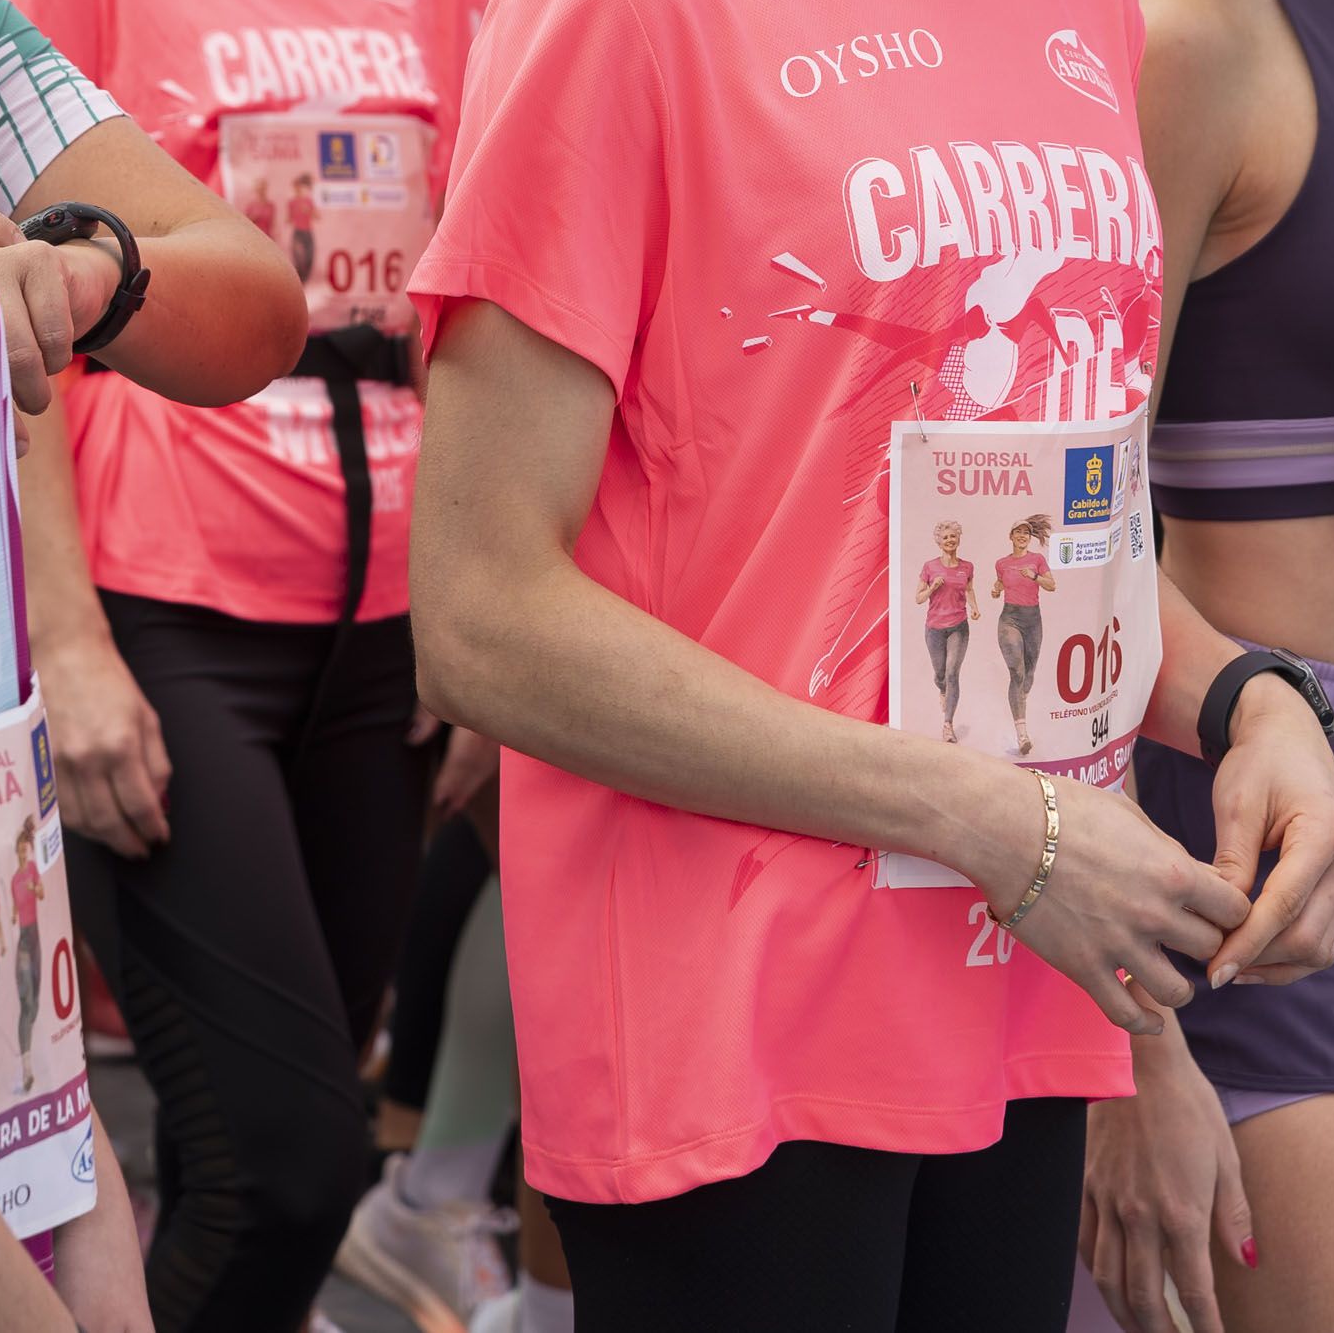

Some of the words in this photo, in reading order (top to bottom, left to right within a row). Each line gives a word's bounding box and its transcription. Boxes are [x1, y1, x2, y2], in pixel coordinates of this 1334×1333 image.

[201, 25, 439, 108] CARRERA
[780, 28, 943, 98] OYSHO
[842, 141, 1163, 282] CARRERA
[326, 249, 405, 293] 016
[932, 451, 956, 467] TU
[961, 451, 1033, 468] DORSAL
[936, 469, 1033, 496] SUMA
[1072, 497, 1101, 510] Cabildo
[1068, 509, 1088, 519] Gran
[1057, 616, 1123, 704] 016
[1050, 706, 1088, 720] TELÉFONO
[1092, 709, 1109, 748] 944
[966, 902, 1015, 967] 20
[28, 1106, 51, 1138] DE
[56, 1093, 76, 1126] LA
